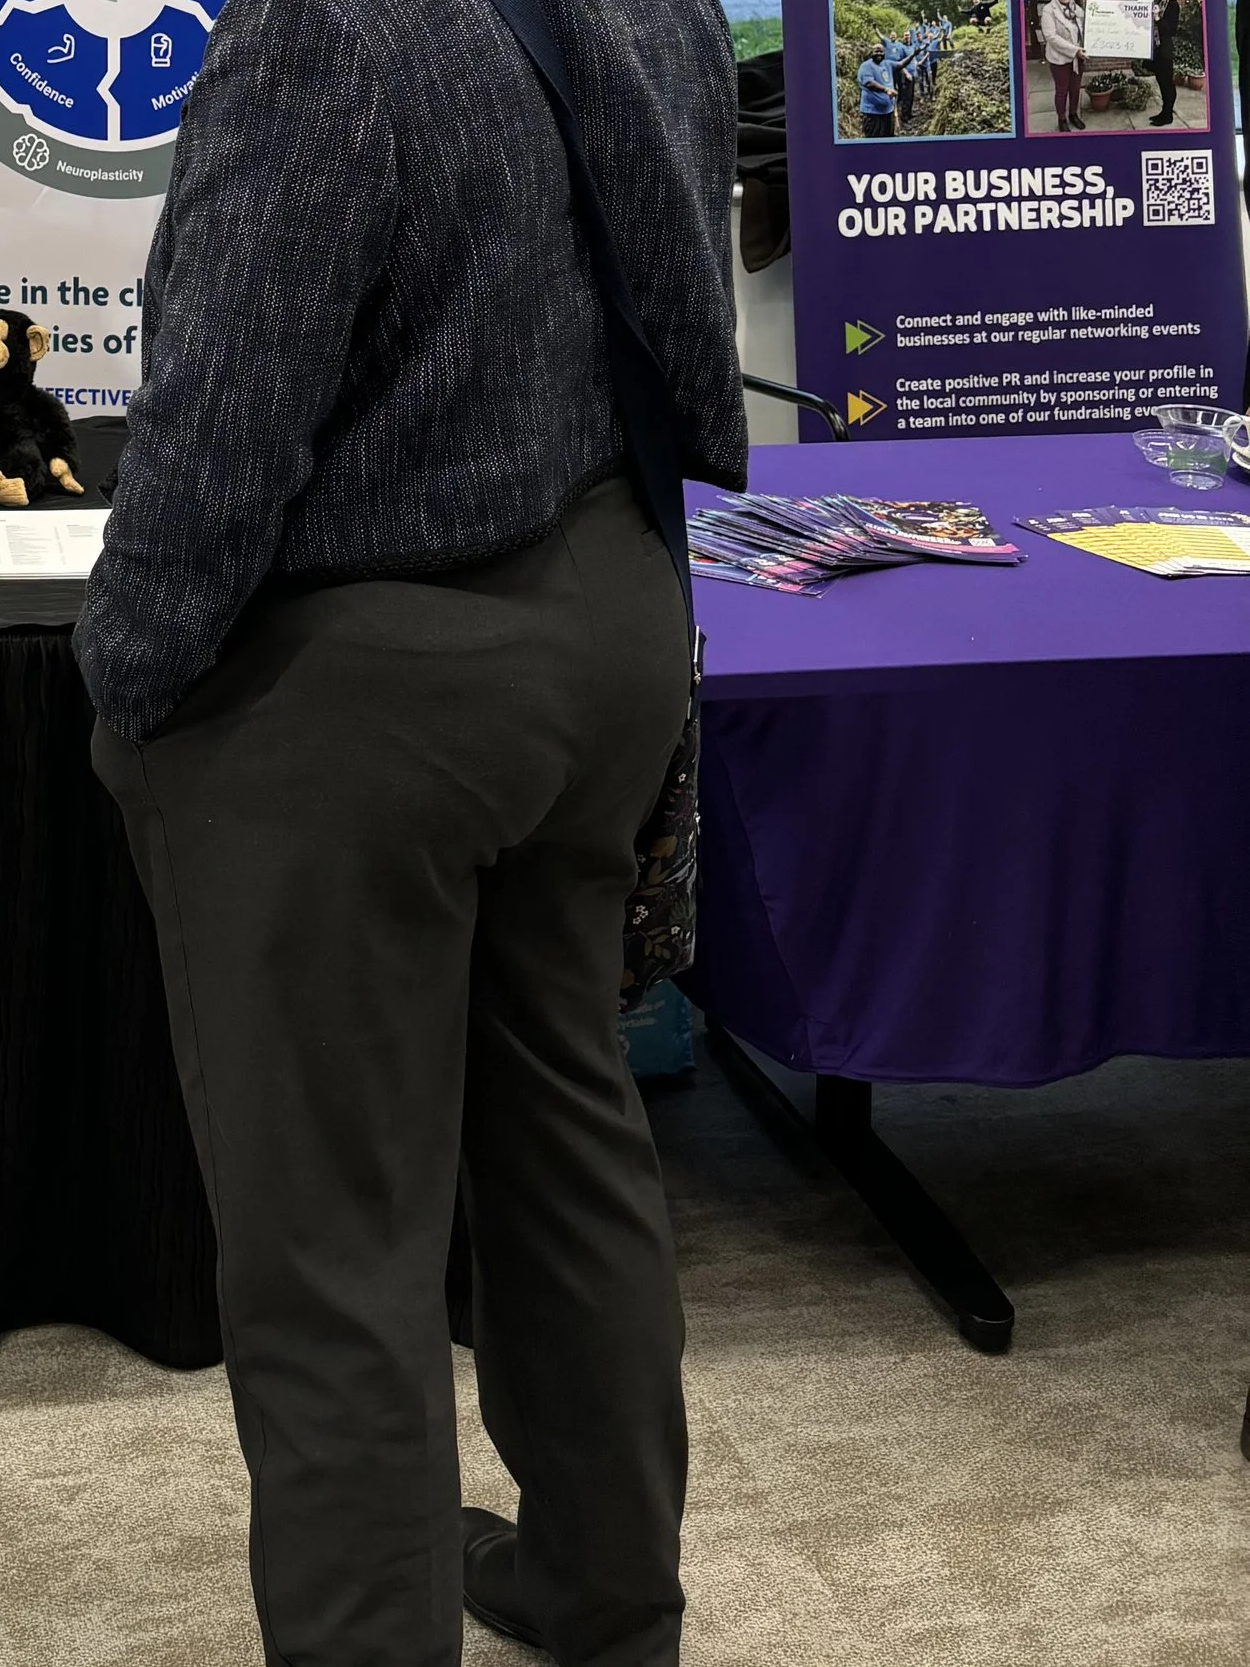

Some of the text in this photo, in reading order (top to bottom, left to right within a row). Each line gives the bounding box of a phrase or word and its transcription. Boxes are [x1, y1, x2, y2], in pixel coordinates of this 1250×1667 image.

[1133, 11, 1149, 19] YOU
[9, 51, 75, 109] Confidence
[56, 159, 144, 183] Neuroplasticity
[848, 165, 1115, 204] YOUR BUSINESS,
[837, 197, 1135, 238] OUR PARTNERSHIP
[21, 277, 48, 305] in
[57, 276, 109, 306] the
[896, 303, 1154, 331] Connect and engage with like-minded
[103, 325, 138, 354] of
[896, 321, 1201, 348] businesses at our regular networking events
[896, 364, 1214, 392] Create positive PR and increase your profile in
[896, 382, 1219, 410] the local community by sponsoring or entering
[897, 417, 906, 429] a
[907, 414, 946, 428] team
[948, 411, 977, 426] into
[979, 412, 1006, 425] one
[1008, 409, 1024, 424] of
[1025, 409, 1051, 423] our
[1053, 404, 1132, 422] fundraising
